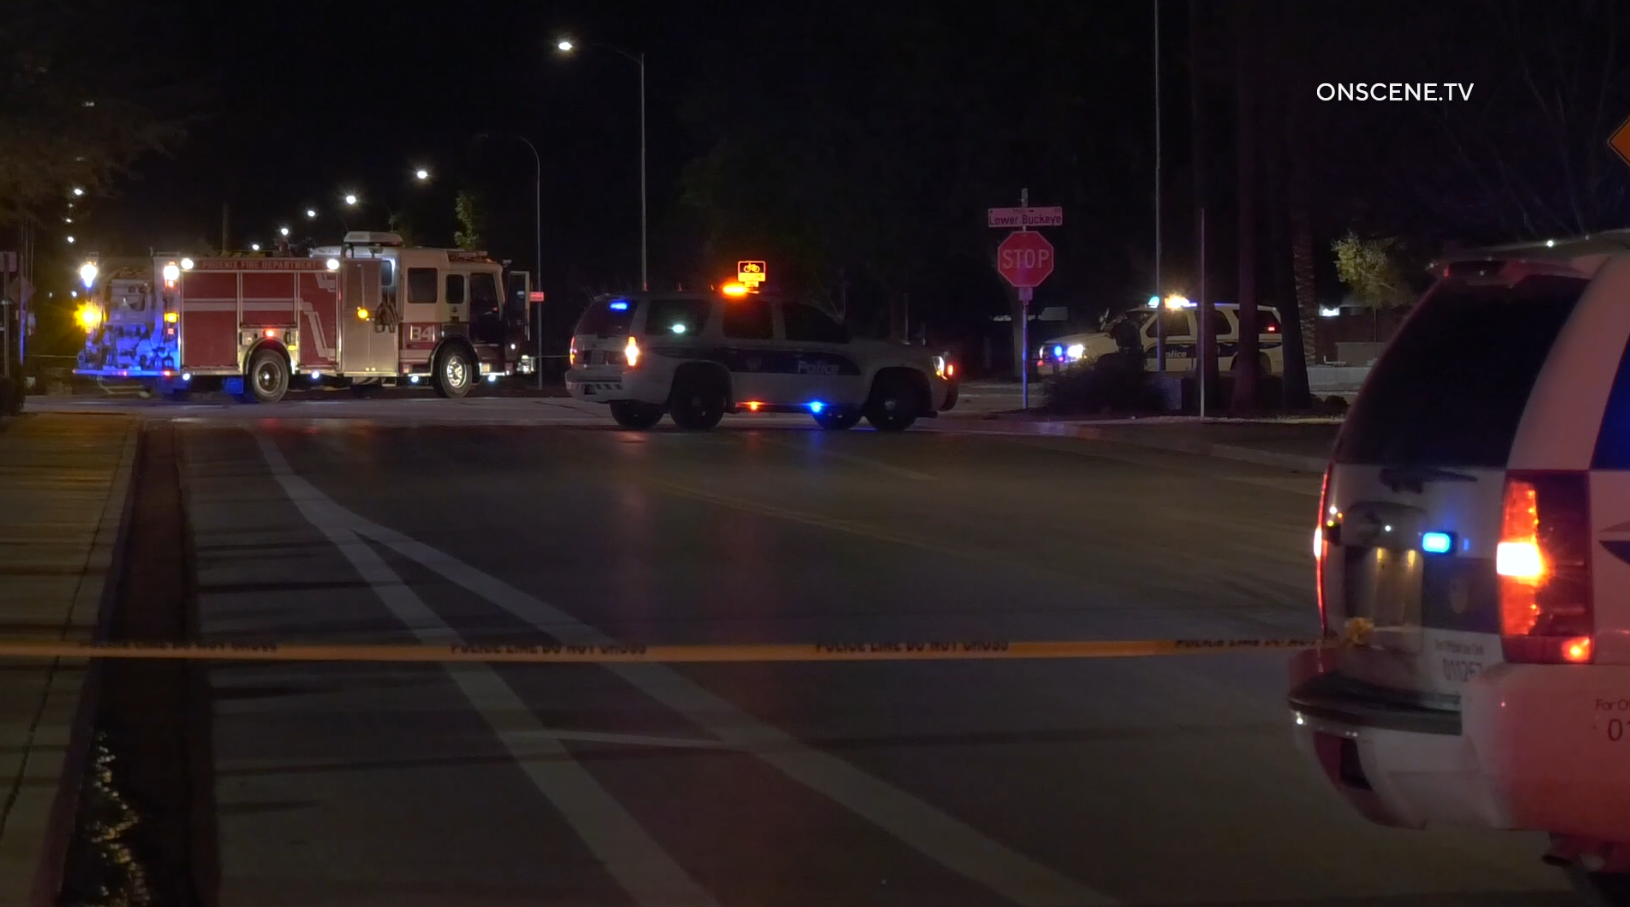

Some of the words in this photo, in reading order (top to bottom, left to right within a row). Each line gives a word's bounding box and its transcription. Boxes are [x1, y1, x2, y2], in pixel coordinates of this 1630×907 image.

[989, 215, 1018, 225] Lower
[1021, 214, 1062, 226] Buckeye
[1002, 248, 1050, 269] STOP
[202, 260, 239, 270] PHOENIX
[240, 260, 261, 270] FIRE
[261, 260, 317, 270] DEPARTMENT
[1165, 349, 1188, 358] olice
[797, 360, 840, 375] Police
[1595, 698, 1613, 711] For
[1617, 698, 1630, 711] O
